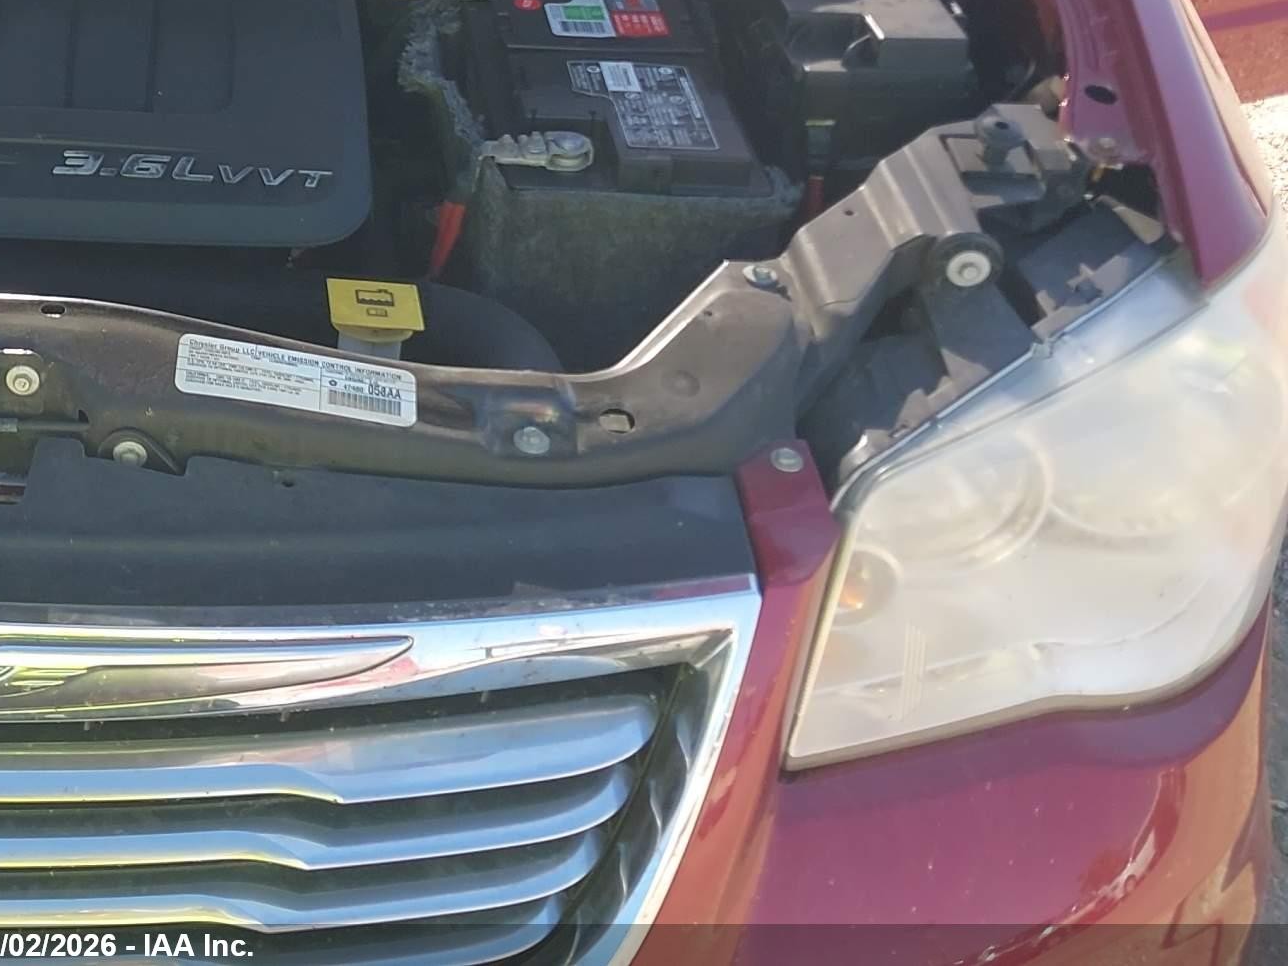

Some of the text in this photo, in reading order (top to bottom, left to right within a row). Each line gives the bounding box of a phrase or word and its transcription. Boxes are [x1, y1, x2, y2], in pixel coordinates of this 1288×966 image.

[189, 338, 217, 350] Chrysler
[258, 349, 286, 362] VEHICLE
[287, 354, 319, 368] EMISSION
[321, 360, 352, 374] CONTROL
[354, 366, 402, 381] INFORMATION
